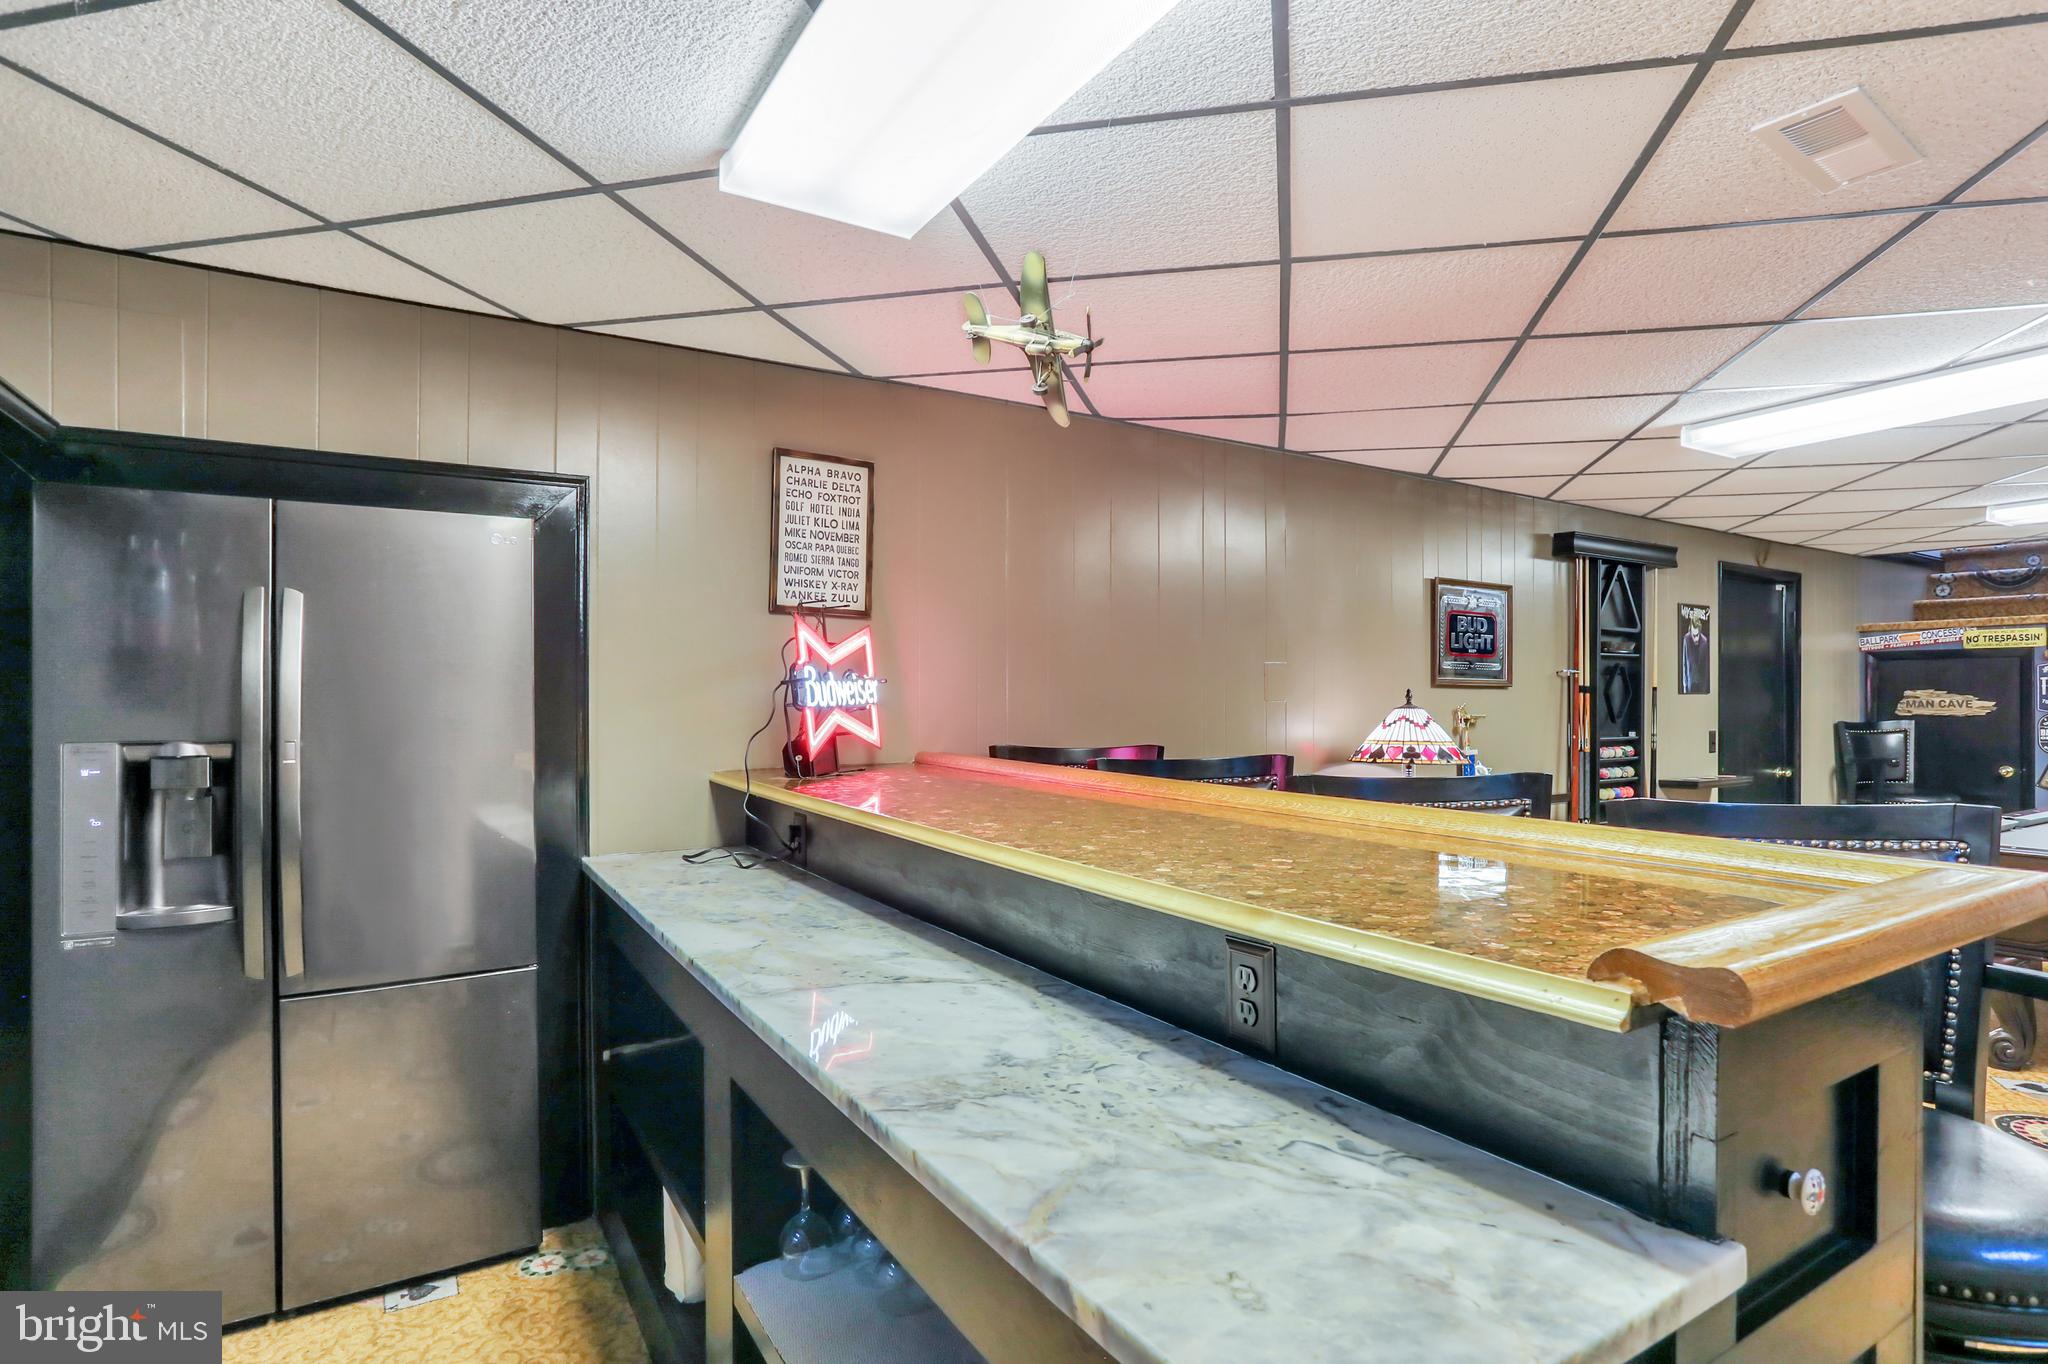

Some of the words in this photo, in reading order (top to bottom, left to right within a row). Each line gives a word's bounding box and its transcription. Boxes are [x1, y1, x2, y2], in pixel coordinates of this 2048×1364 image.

[787, 464, 821, 476] ALPHA
[827, 469, 861, 481] BRAVO
[786, 476, 827, 489] CHARLIE
[832, 482, 861, 493] DELTA
[786, 489, 812, 499] ECHO
[818, 493, 861, 505] FOXTROT
[786, 501, 804, 511] GOLF
[810, 503, 833, 515] HOTEL
[839, 507, 860, 518] INDIA
[785, 514, 810, 526] JULIET
[814, 518, 838, 529] KILO
[842, 520, 860, 531] LIMA
[785, 527, 806, 538] MIKE
[810, 530, 859, 543] NOVEMBER
[785, 540, 812, 550] OSCAR
[815, 543, 834, 553] PAPA
[837, 546, 859, 555] QUEBEC
[785, 552, 807, 562] ROMEO
[811, 555, 834, 566] SIERRA
[838, 557, 859, 567] TANGO
[784, 565, 824, 576] UNIFORM
[828, 568, 859, 579] VICTOR
[784, 578, 827, 589] WHISKEY
[831, 582, 858, 592] X-RAY
[784, 590, 826, 601] YANKEE
[831, 594, 858, 603] ZULU
[1457, 616, 1487, 633] BUD
[1451, 632, 1493, 650] LIGHT
[1860, 635, 1898, 646] BALLPARK
[1966, 634, 1980, 644] NO
[1983, 633, 2042, 642] TRESPASSIN'
[804, 665, 878, 707] Budweiser
[1906, 700, 1934, 708] MAN
[1938, 700, 1973, 708] CAVE
